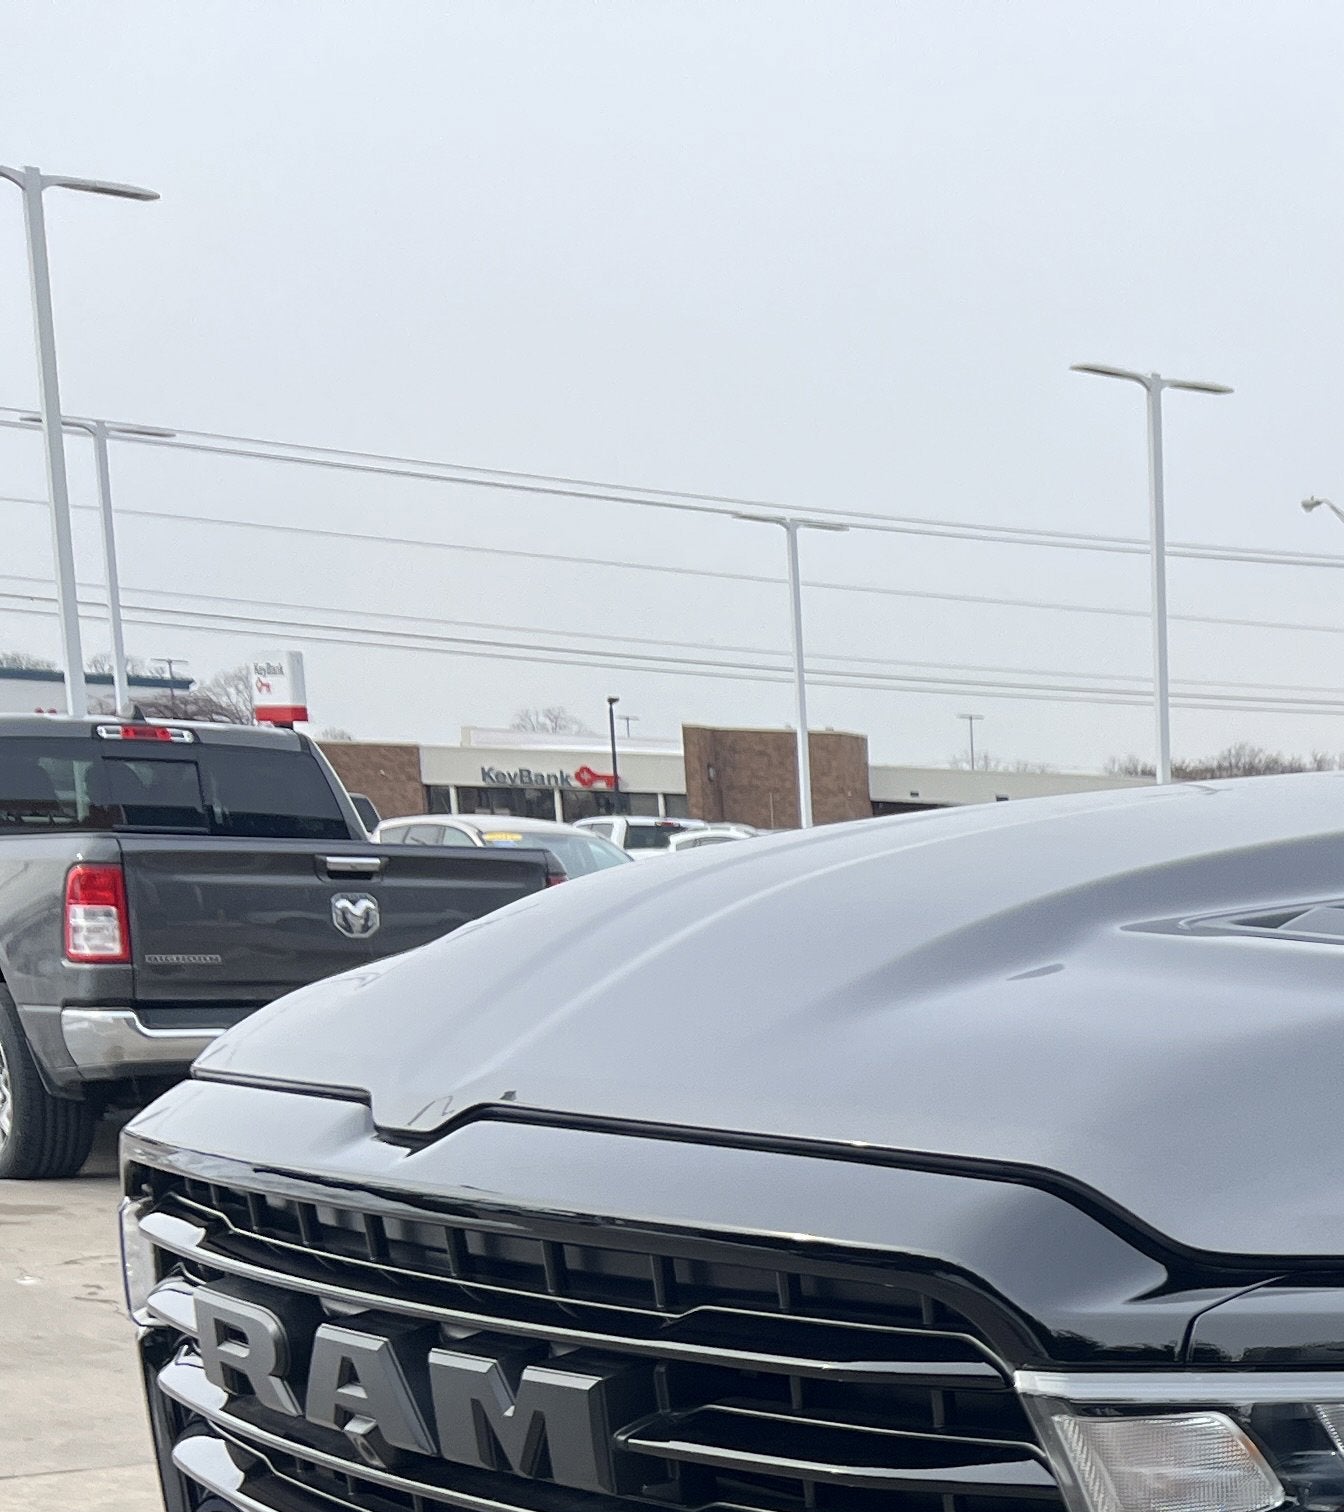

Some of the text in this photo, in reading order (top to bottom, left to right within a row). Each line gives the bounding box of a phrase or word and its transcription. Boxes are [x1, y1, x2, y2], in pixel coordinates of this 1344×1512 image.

[253, 662, 284, 677] KeyBank
[480, 766, 572, 787] KeyBank
[193, 1283, 618, 1493] RAM
